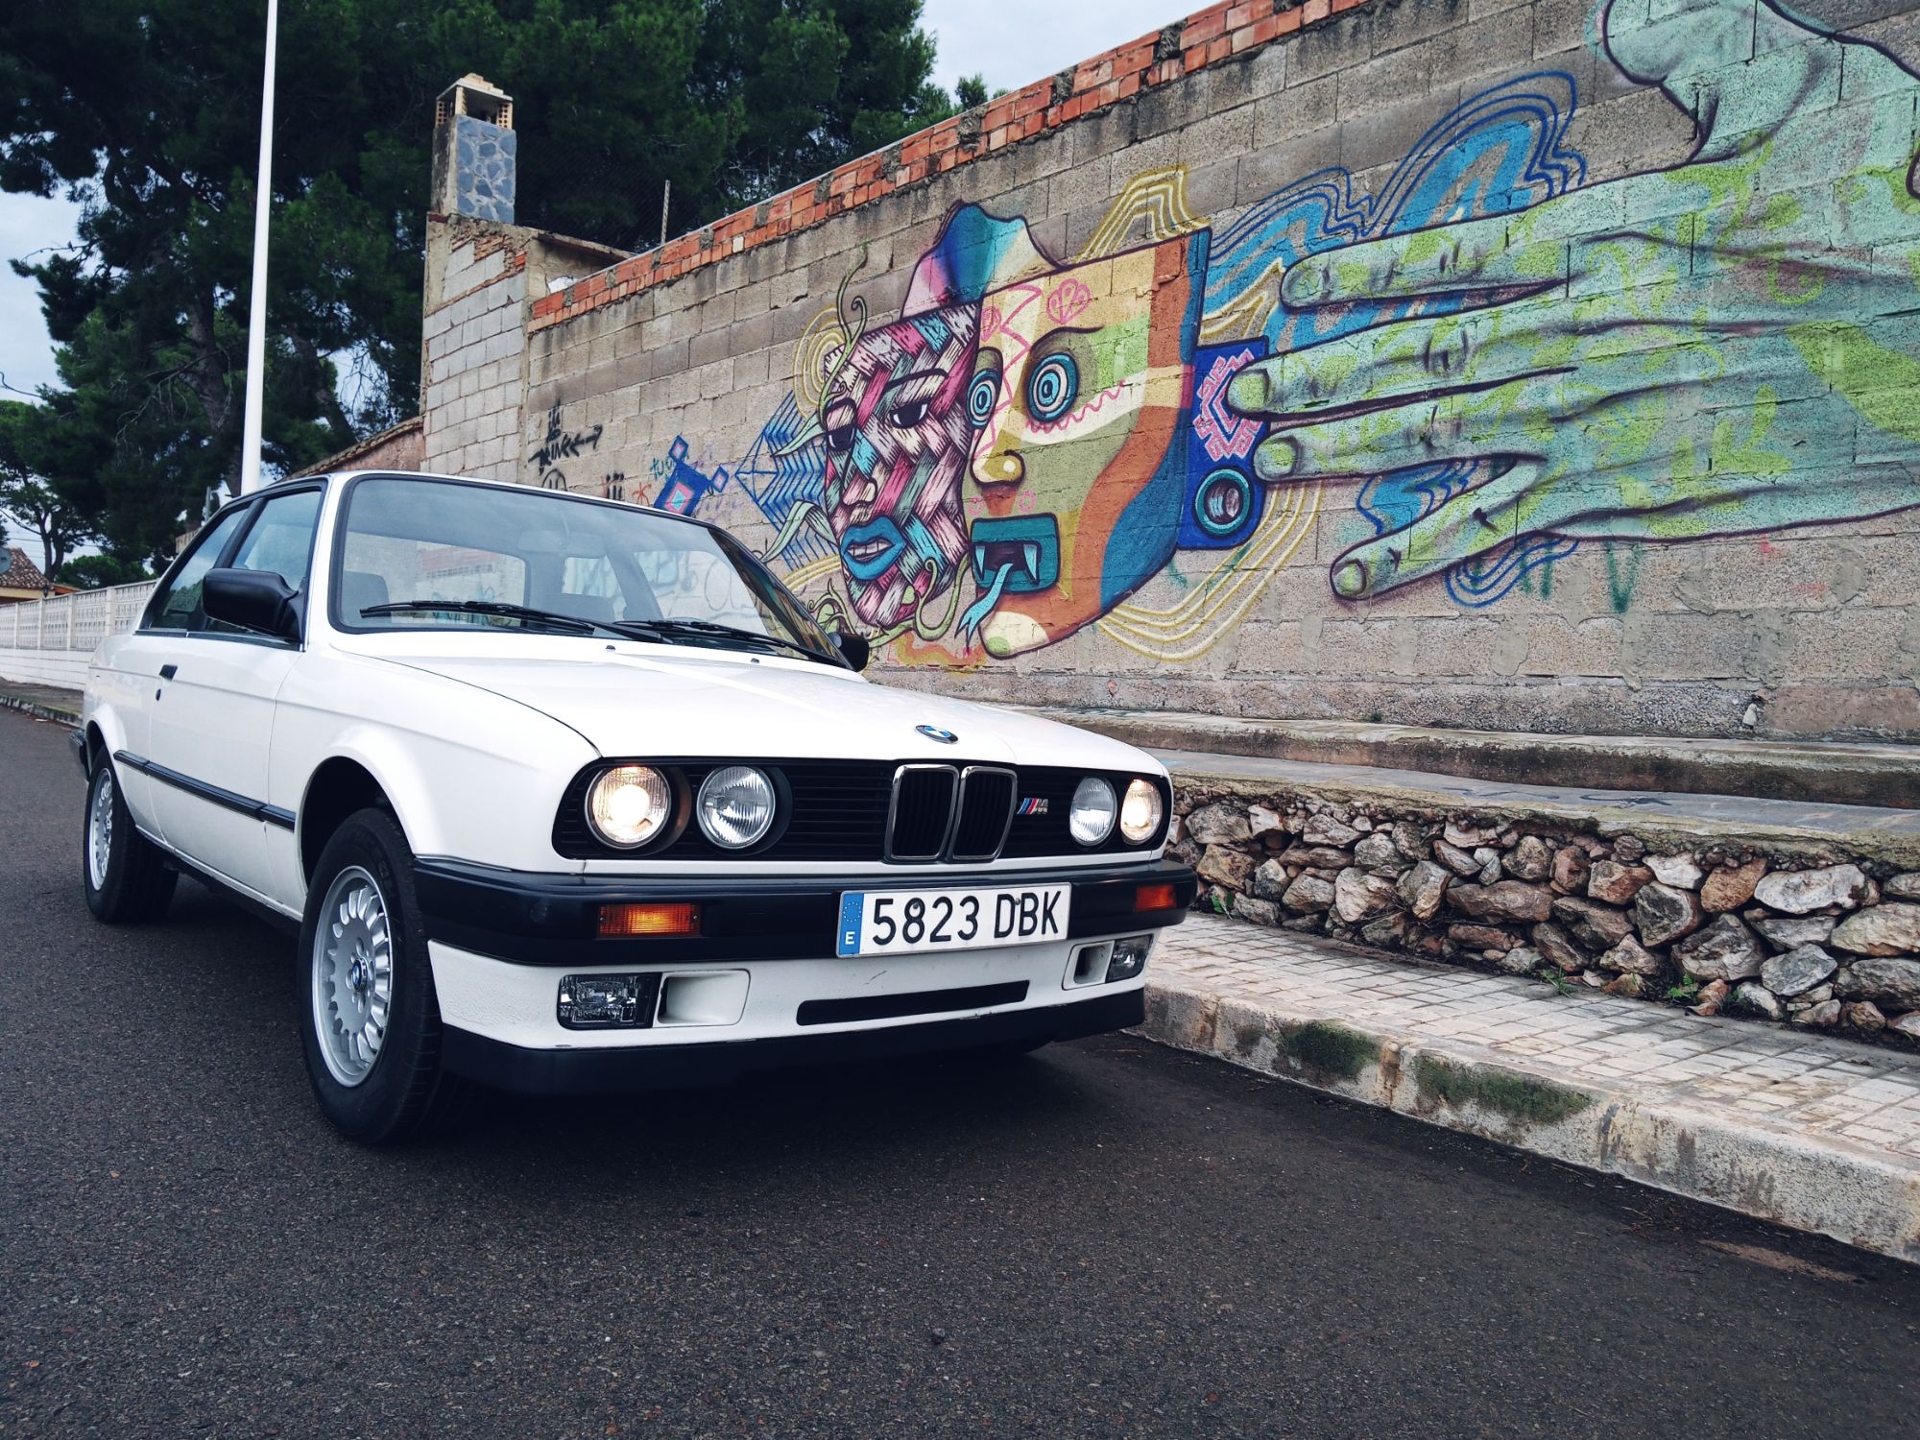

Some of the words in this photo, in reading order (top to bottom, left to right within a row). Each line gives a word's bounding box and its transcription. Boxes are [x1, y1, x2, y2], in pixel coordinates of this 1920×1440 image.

[872, 895, 980, 946] 5823
[993, 890, 1062, 939] DBK
[845, 931, 855, 945] E
